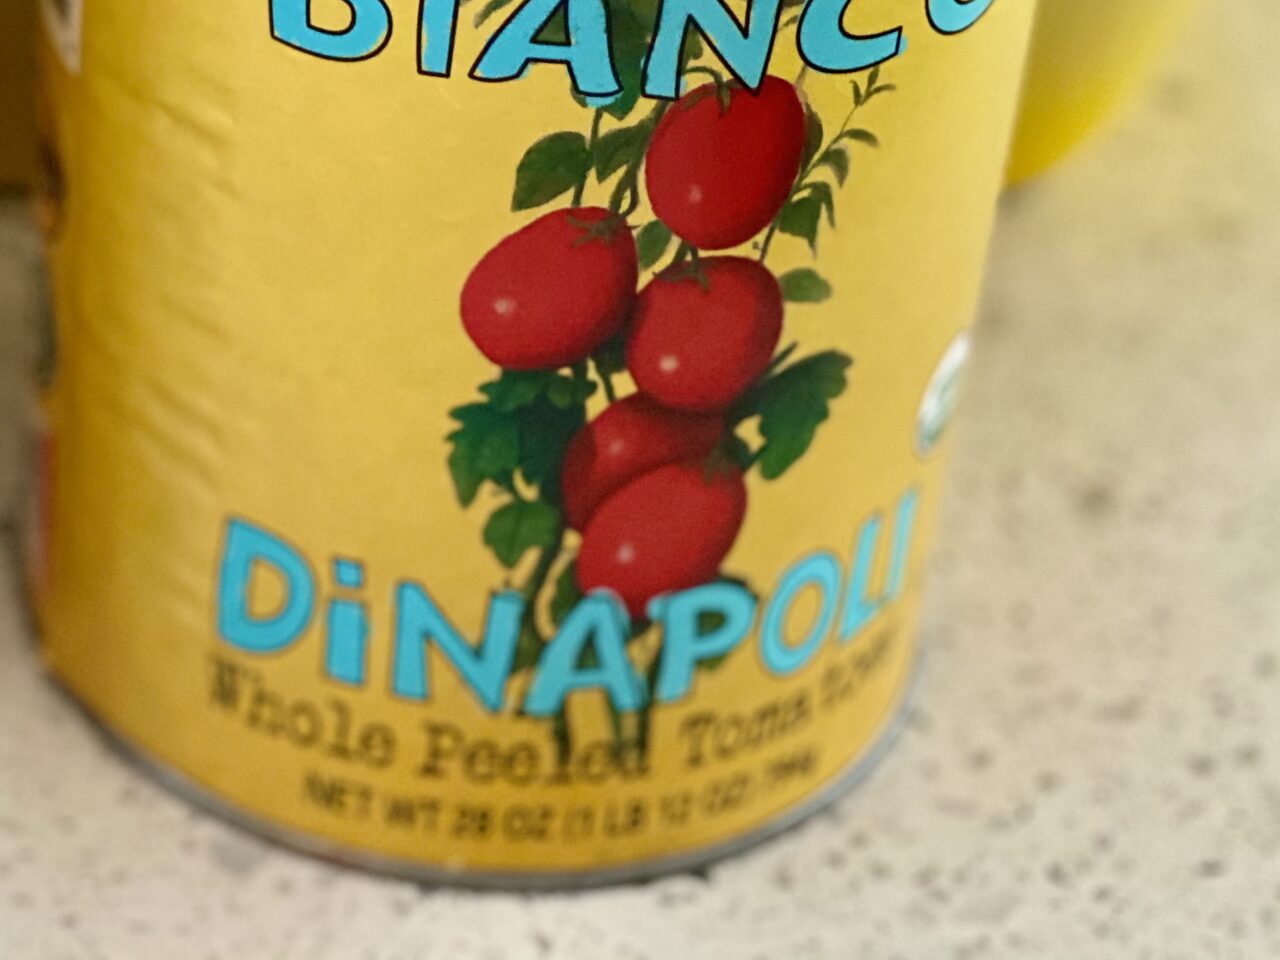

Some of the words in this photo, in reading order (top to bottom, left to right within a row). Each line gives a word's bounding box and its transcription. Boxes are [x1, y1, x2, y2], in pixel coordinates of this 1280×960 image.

[215, 488, 918, 716] DiNAPOLI
[209, 653, 397, 770] Whole
[418, 718, 649, 788] Peeled
